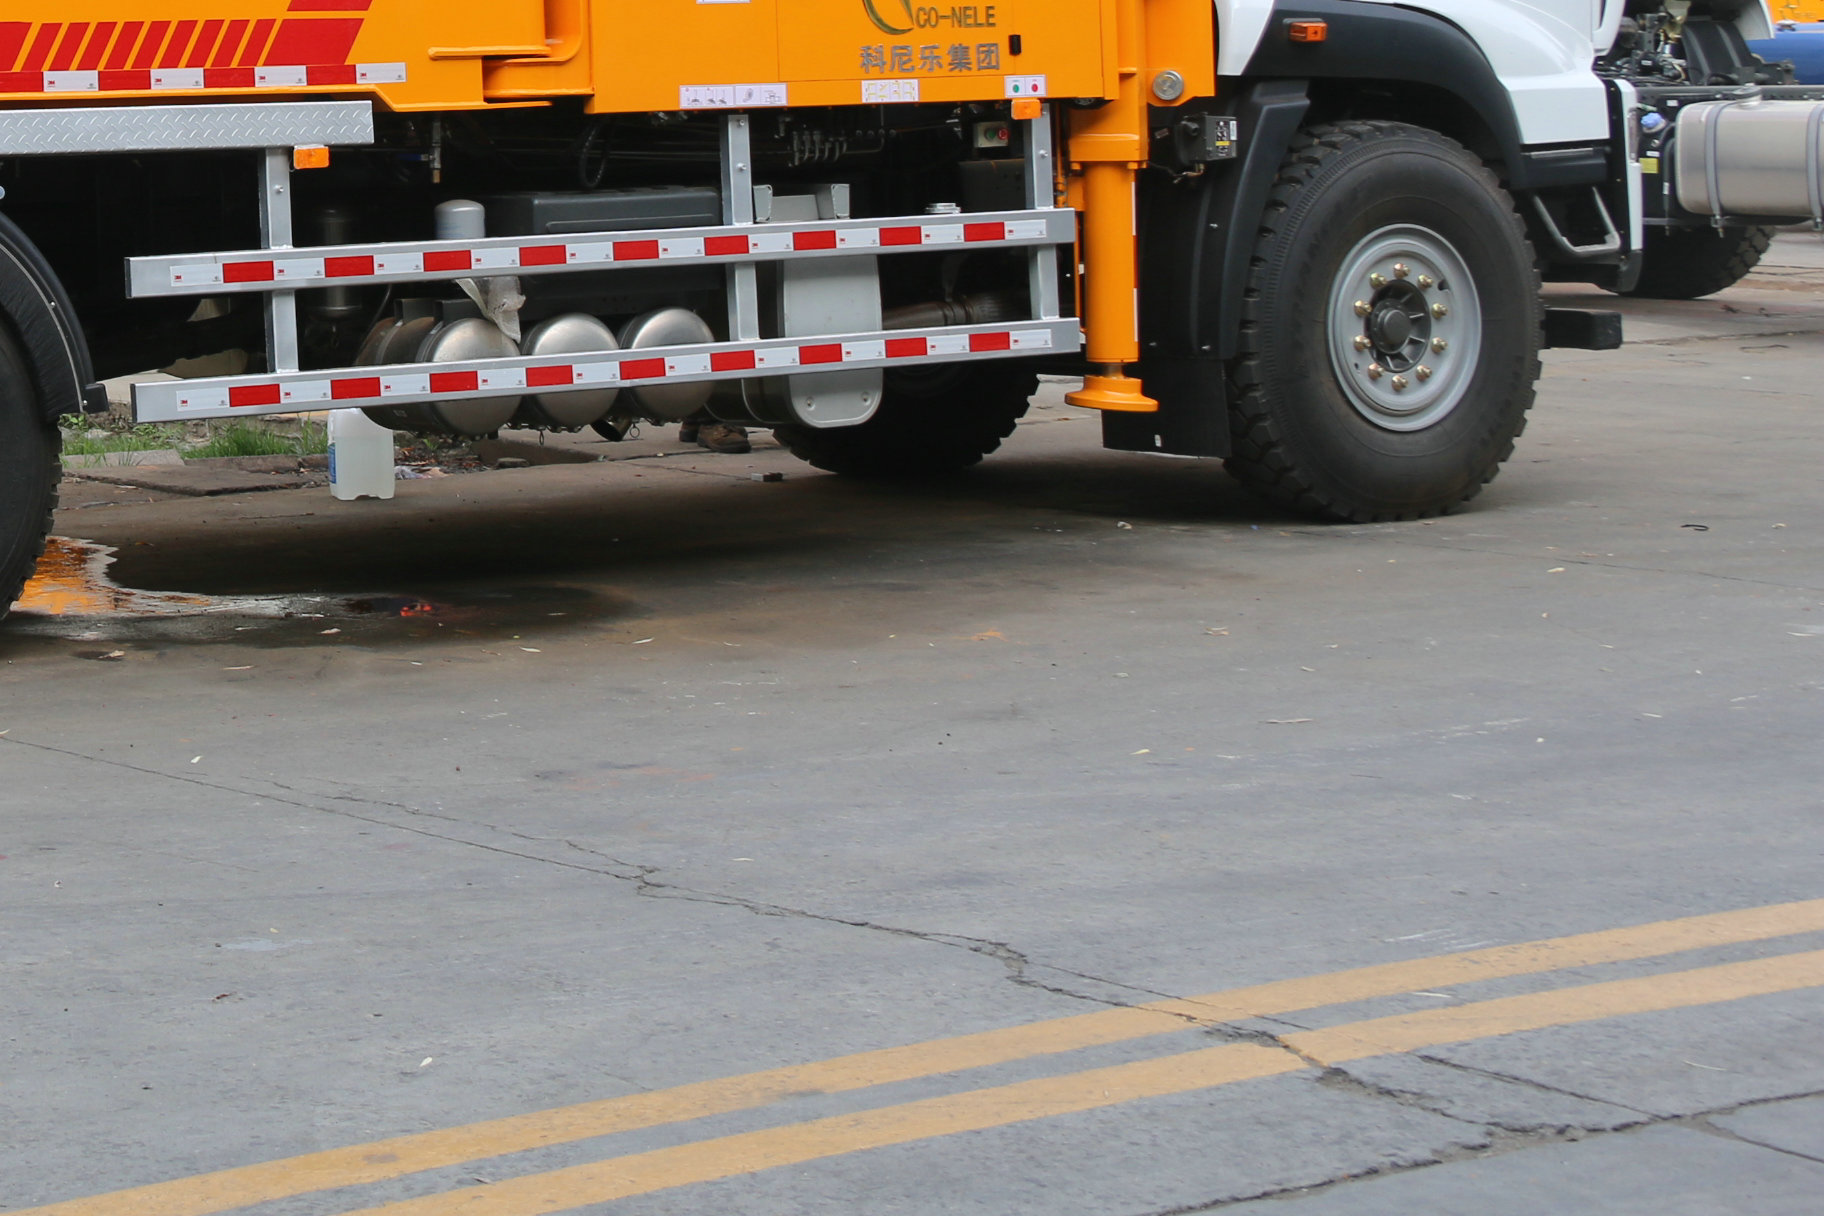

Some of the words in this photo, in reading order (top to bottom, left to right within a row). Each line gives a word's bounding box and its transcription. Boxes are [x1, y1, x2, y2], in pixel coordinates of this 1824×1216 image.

[916, 6, 996, 29] CO-NELE
[860, 44, 1001, 73] 科尼乐集团
